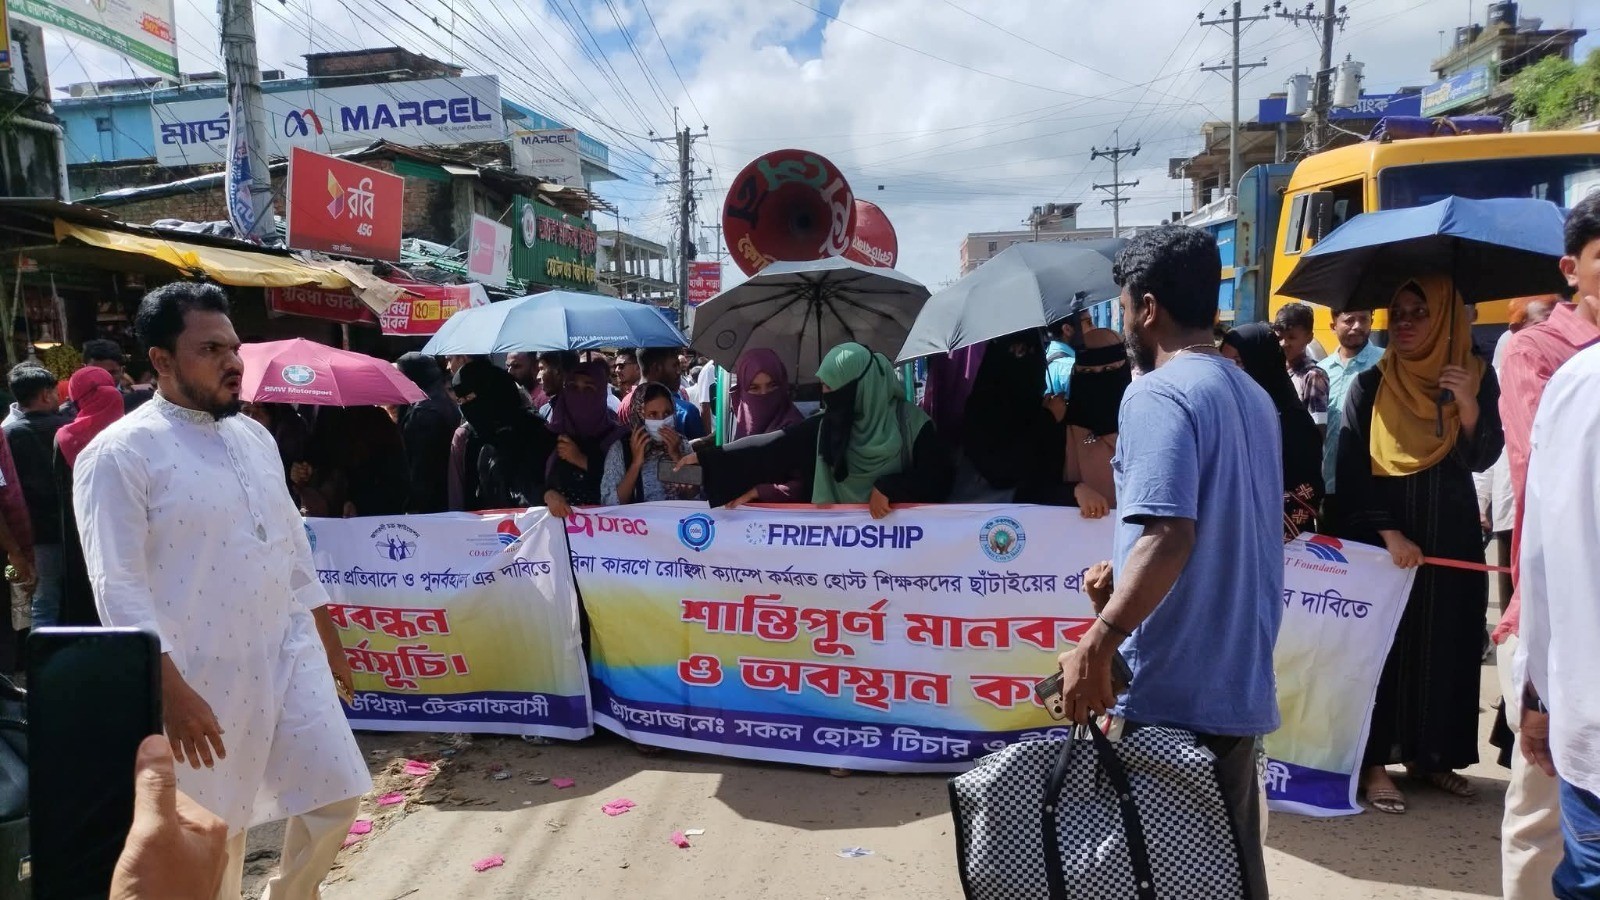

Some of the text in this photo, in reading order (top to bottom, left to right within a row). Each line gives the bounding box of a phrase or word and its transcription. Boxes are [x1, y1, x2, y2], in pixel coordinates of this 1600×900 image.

[341, 97, 492, 132] MARCEL
[521, 134, 572, 145] MARCEL
[347, 177, 375, 220] রবি
[288, 387, 333, 397] Motorsport
[595, 513, 649, 537] brac
[767, 523, 924, 549] FRIENDSHIP
[344, 565, 398, 588] প্রতিবাদে
[402, 573, 415, 587] ও
[472, 571, 496, 586] এর
[500, 557, 551, 579] দাবিতে
[601, 556, 651, 576] কারণে
[710, 565, 763, 584] ক্যাম্পে
[765, 566, 818, 587] কর্মরত
[824, 569, 868, 592] হোস্ট
[872, 570, 963, 593] শিক্ষকদের
[968, 569, 1059, 597] ছাঁটাইয়ের
[1294, 558, 1348, 576] Foundation
[1300, 588, 1374, 619] দাবিতে
[681, 593, 891, 656] শান্তিপূর্ণ
[678, 653, 723, 687] ও
[738, 657, 952, 712] অবস্থান
[734, 719, 804, 743] সকল
[812, 725, 882, 749] হোস্ট
[891, 726, 971, 758] টিচার
